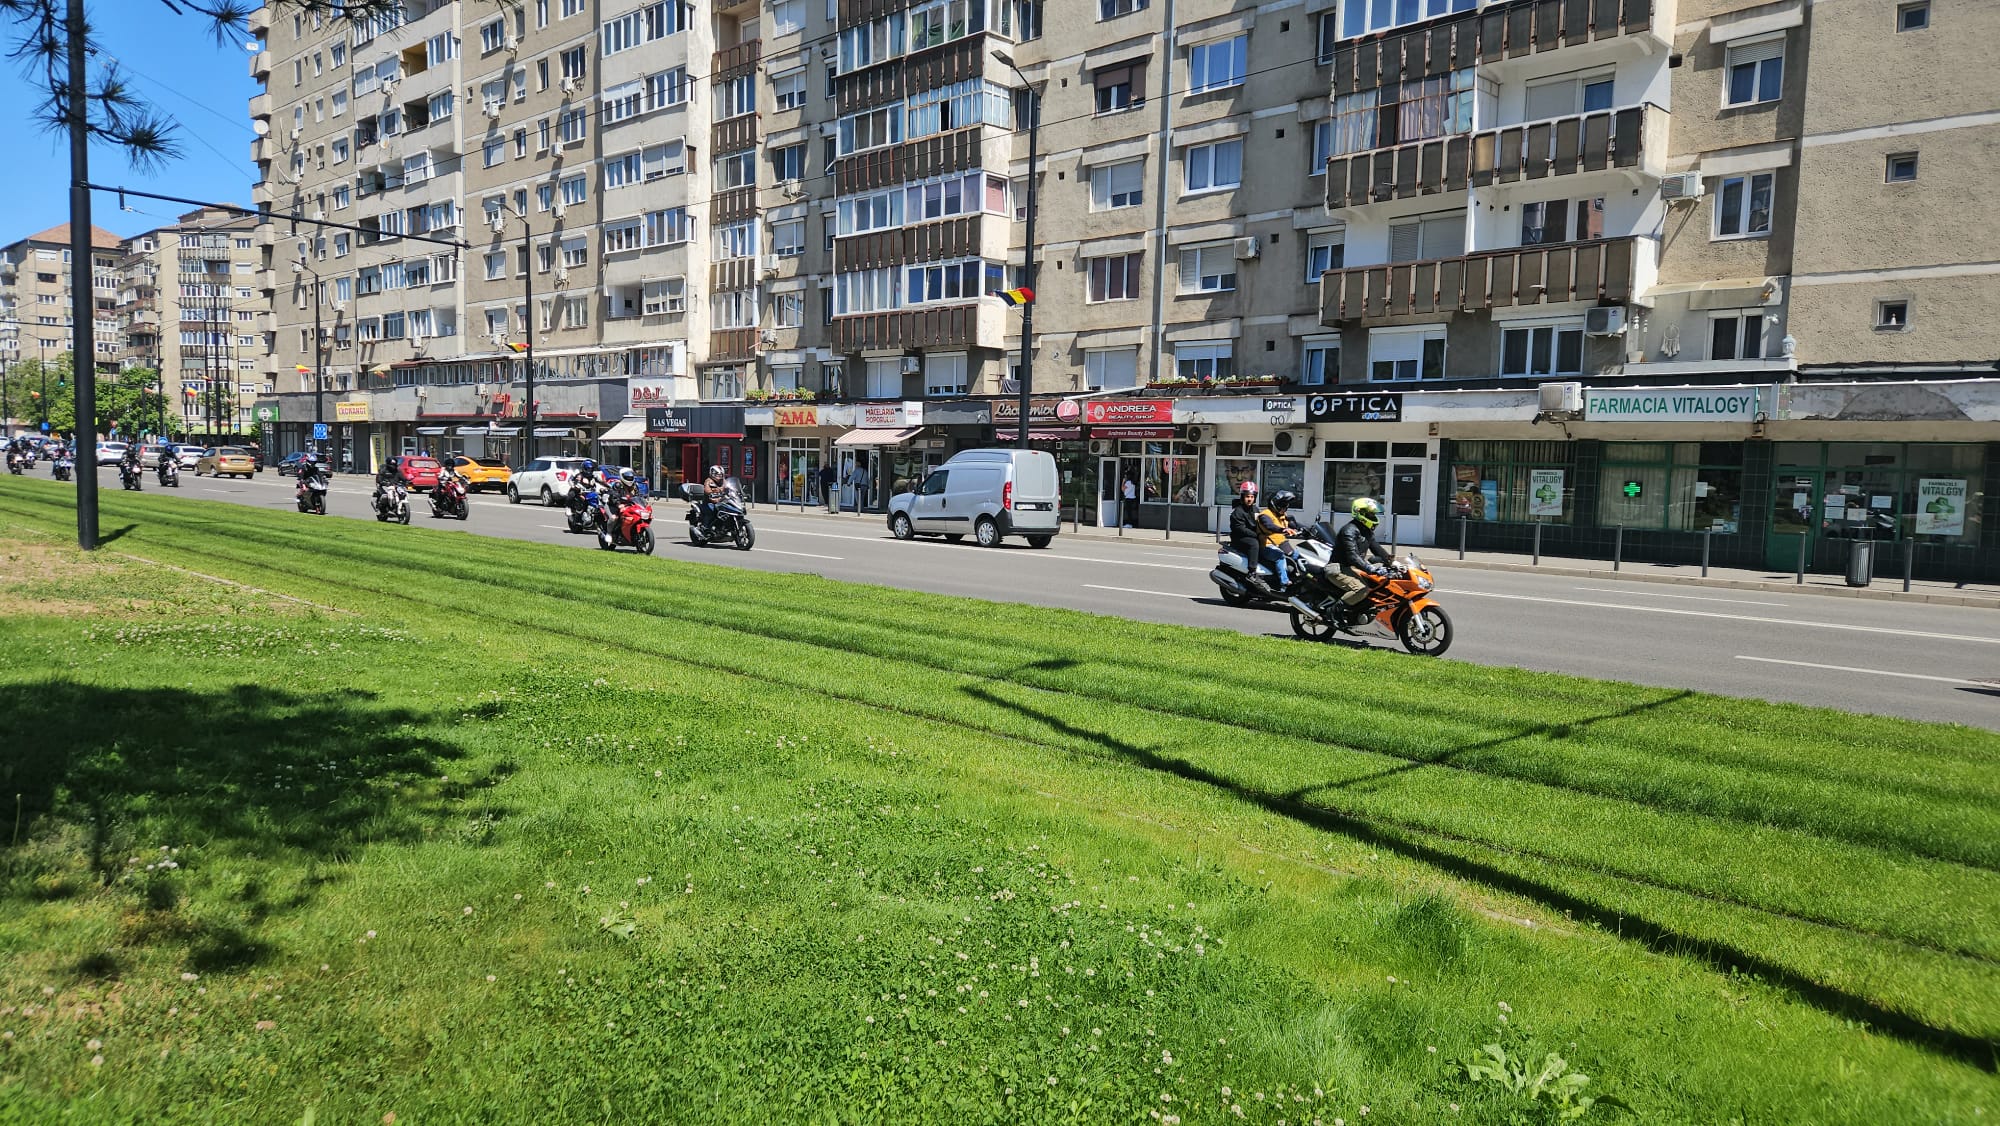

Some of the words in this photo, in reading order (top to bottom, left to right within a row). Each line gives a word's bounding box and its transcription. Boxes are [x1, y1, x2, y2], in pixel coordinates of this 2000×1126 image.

[1106, 404, 1157, 413] ANDREEA
[1267, 400, 1292, 410] OPTICA
[1310, 395, 1397, 416] OPTICA
[1590, 397, 1668, 413] FARMACIA
[1672, 396, 1750, 413] VITALOGY
[653, 418, 665, 427] LAS
[666, 418, 687, 427] VEGAS
[780, 411, 817, 425] AMA
[1922, 486, 1964, 496] VITALOGY
